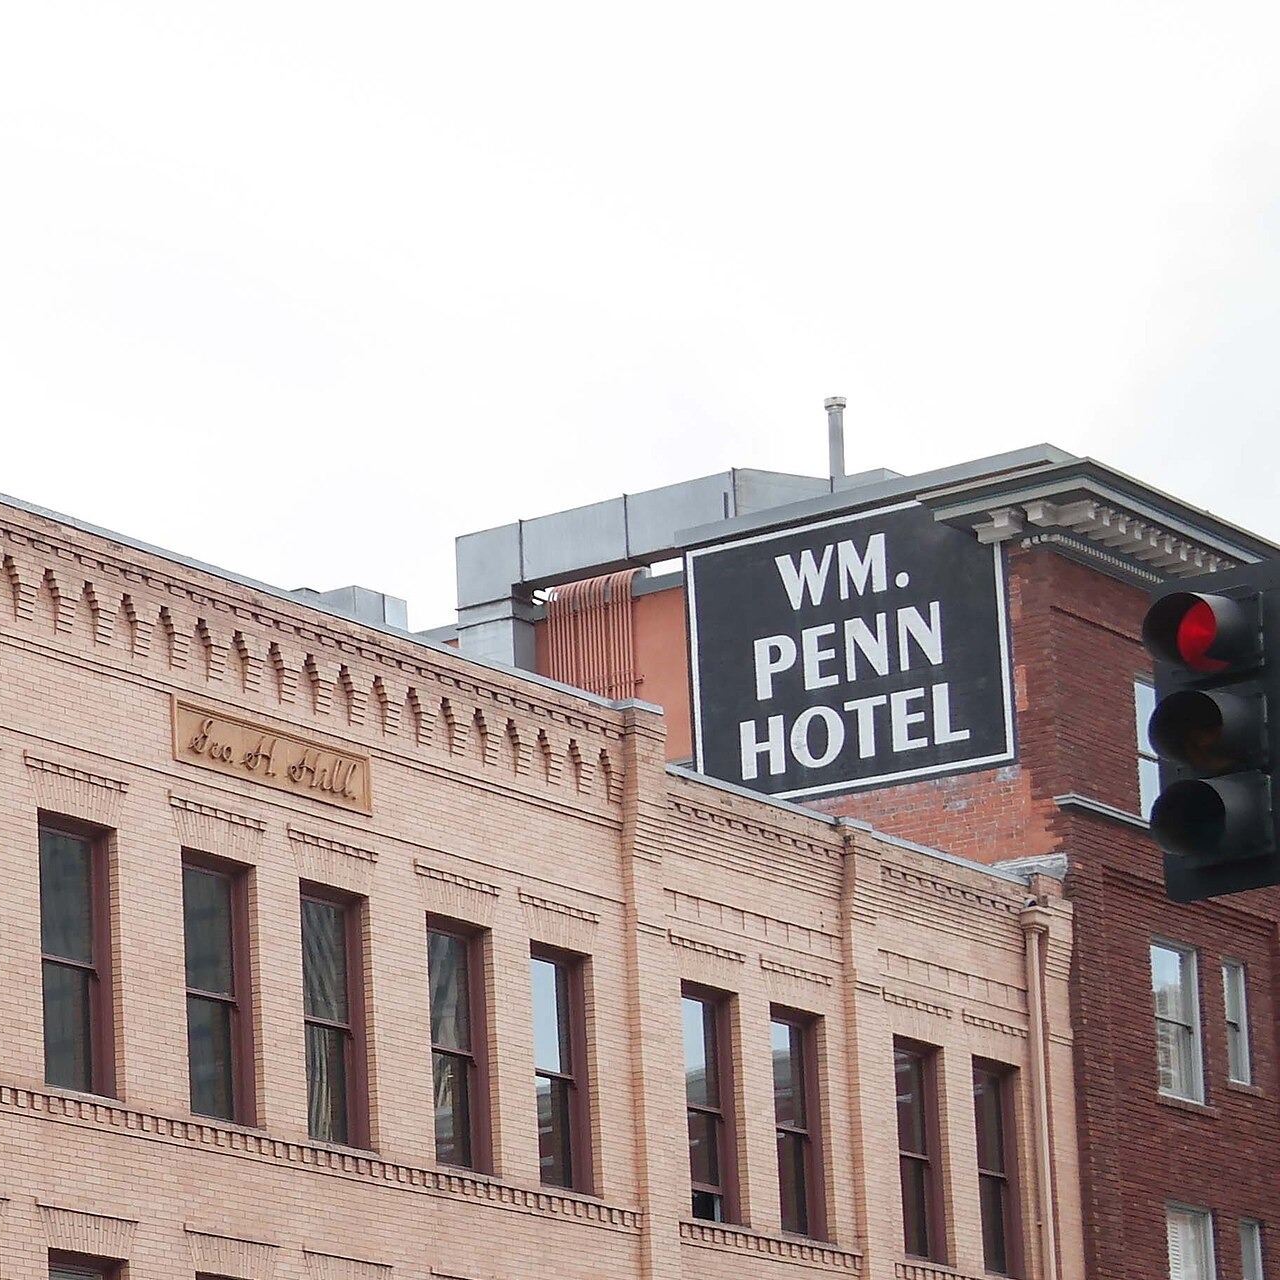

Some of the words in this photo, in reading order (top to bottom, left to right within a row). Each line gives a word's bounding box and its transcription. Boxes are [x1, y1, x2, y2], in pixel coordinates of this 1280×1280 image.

[774, 532, 910, 611] WM.
[753, 601, 943, 701] PENN
[739, 682, 971, 781] HOTEL
